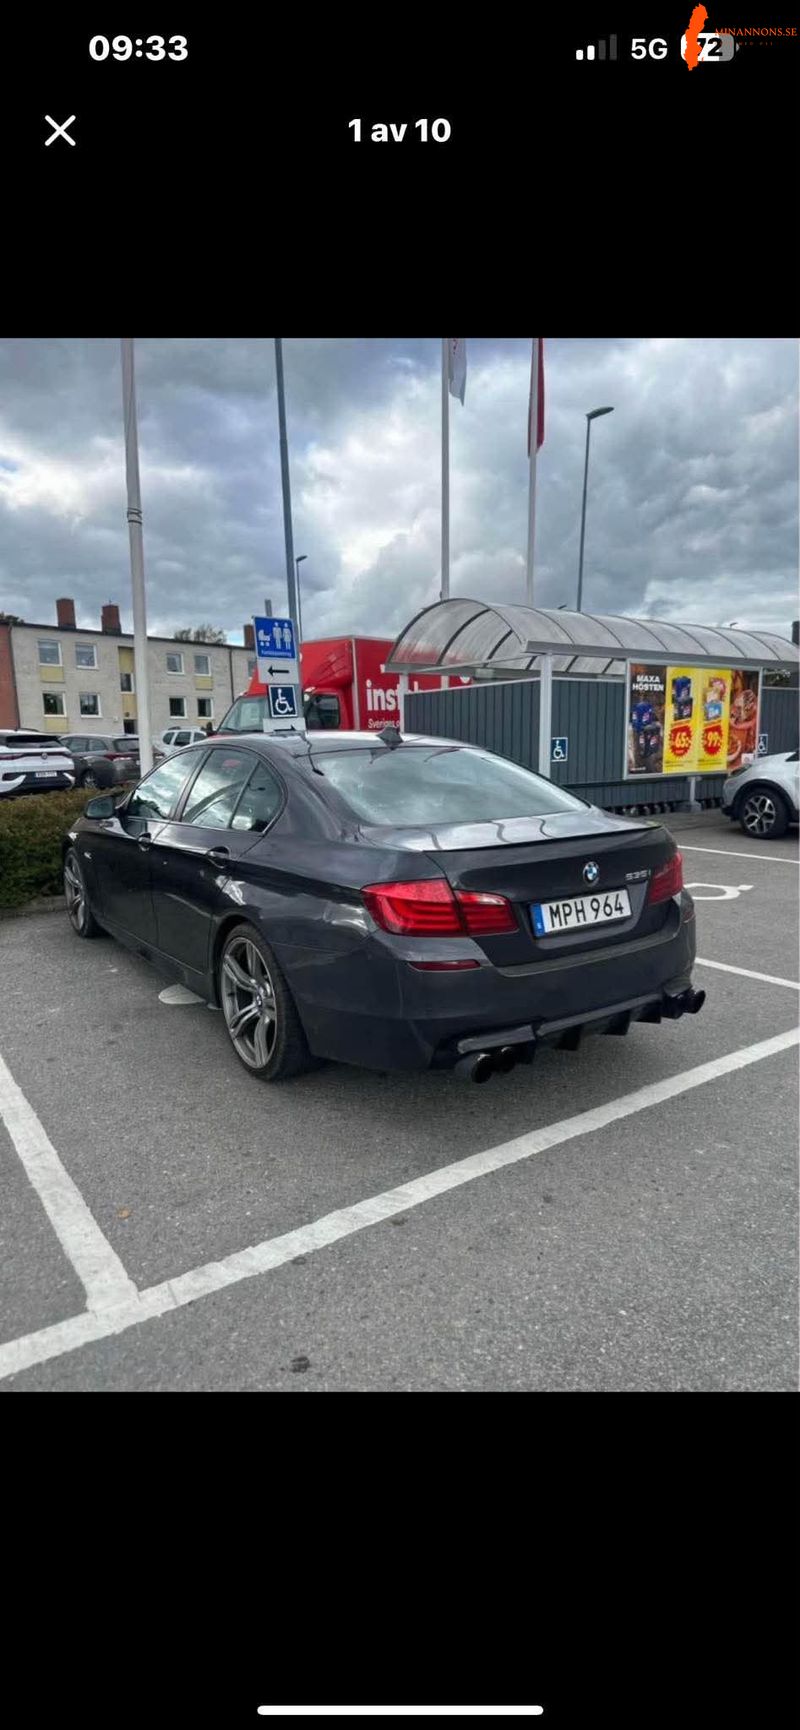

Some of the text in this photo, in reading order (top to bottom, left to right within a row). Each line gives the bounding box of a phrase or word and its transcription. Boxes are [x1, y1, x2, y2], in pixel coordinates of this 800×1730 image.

[636, 674, 660, 683] MAXA
[625, 869, 652, 881] 535i
[549, 893, 624, 929] MPH 964
